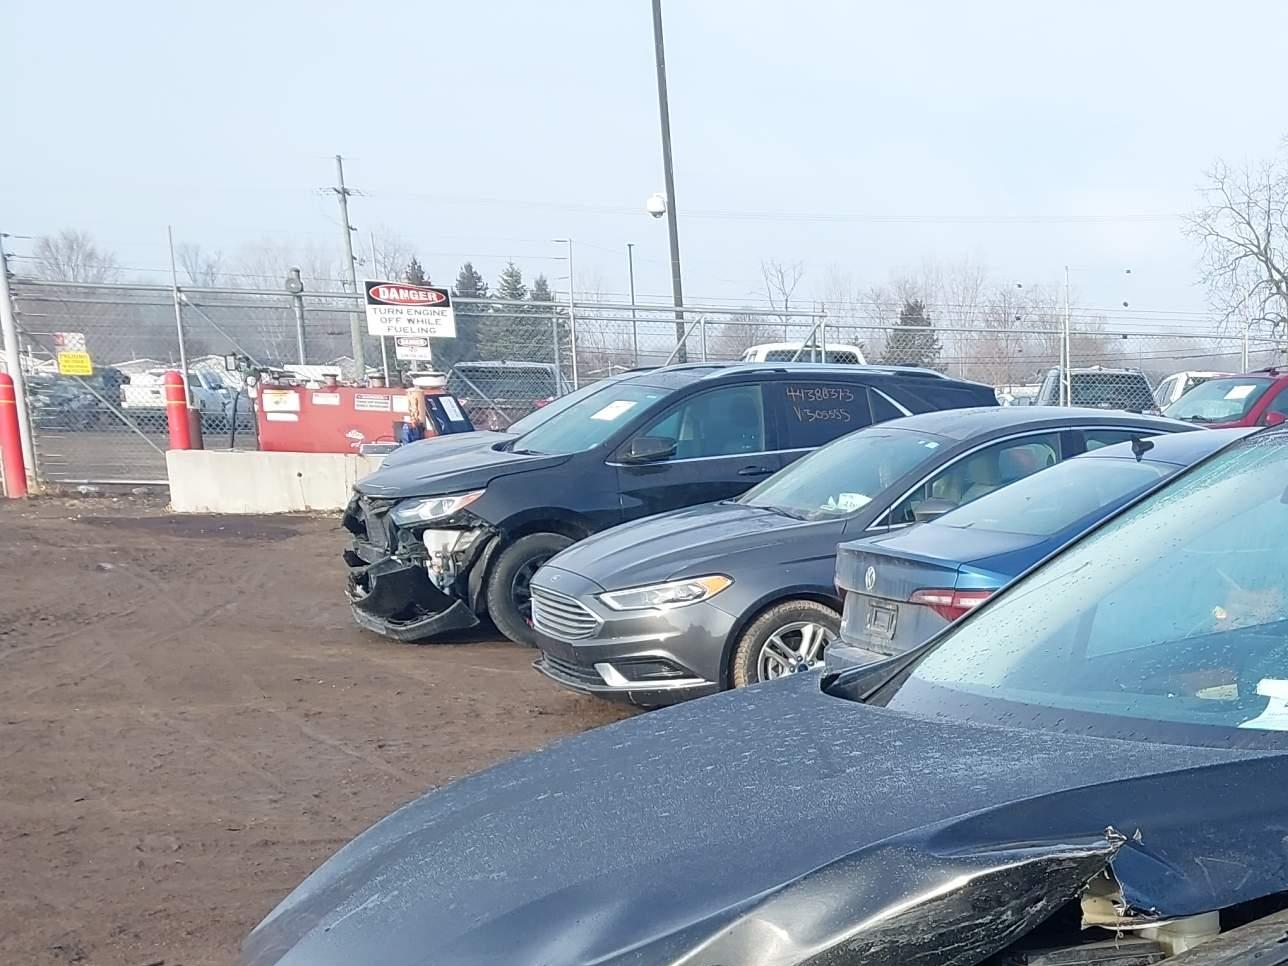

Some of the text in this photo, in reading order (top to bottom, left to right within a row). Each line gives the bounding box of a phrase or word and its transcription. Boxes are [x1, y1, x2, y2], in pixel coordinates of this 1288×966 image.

[378, 287, 438, 302] DANGER
[371, 307, 448, 317] TURN ENGINE
[380, 316, 442, 326] OFF WHILE
[386, 325, 437, 334] FUELING
